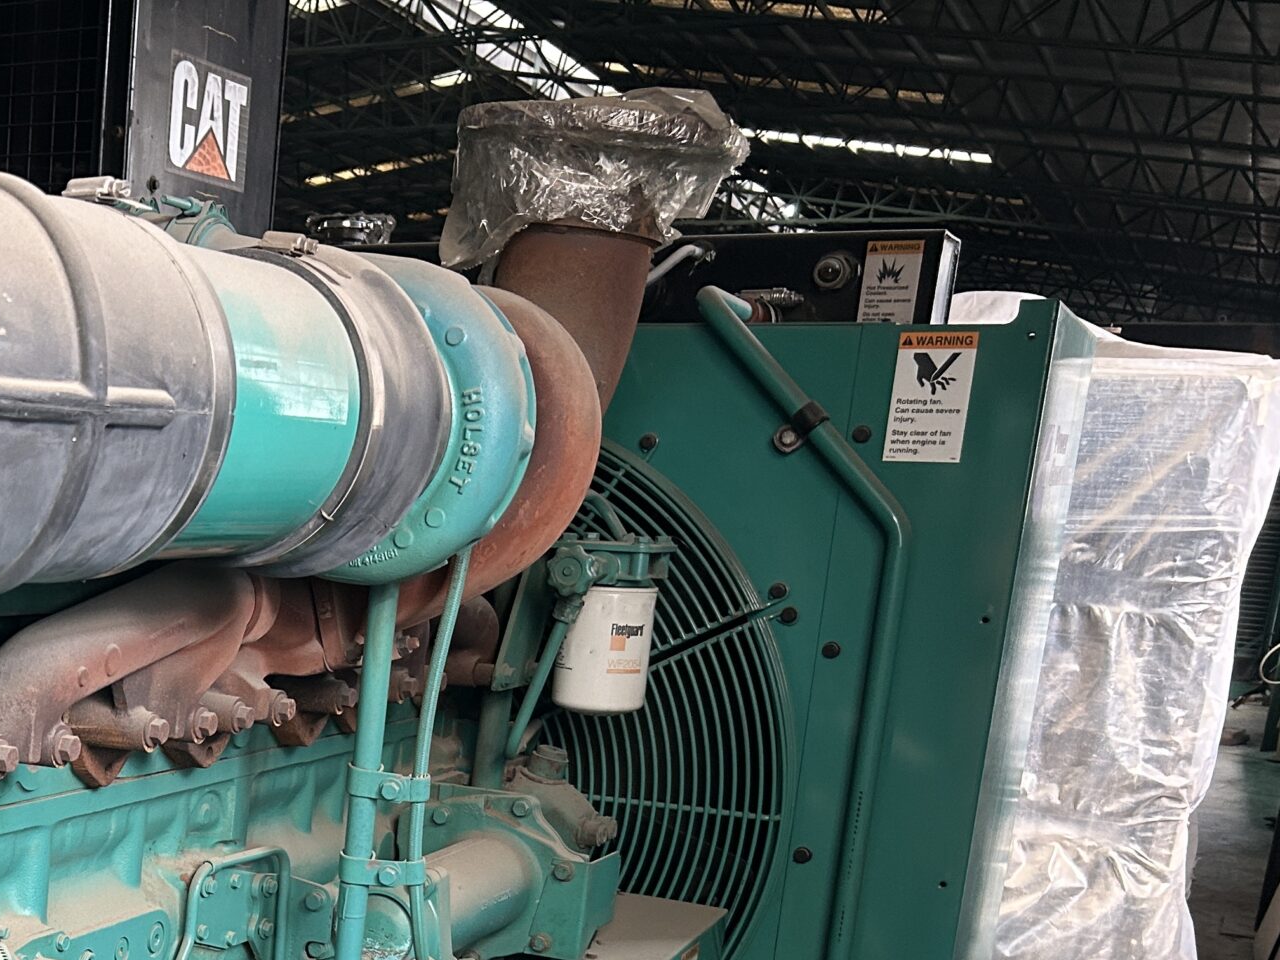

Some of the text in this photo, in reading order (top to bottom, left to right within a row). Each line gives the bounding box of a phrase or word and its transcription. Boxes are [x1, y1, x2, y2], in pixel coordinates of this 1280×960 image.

[169, 60, 248, 182] CAT
[880, 243, 921, 251] WARNING
[916, 335, 974, 346] WARNING
[896, 398, 928, 406] Rotating
[891, 429, 907, 437] Stay
[449, 386, 485, 495] HOLSET
[888, 447, 920, 455] running.
